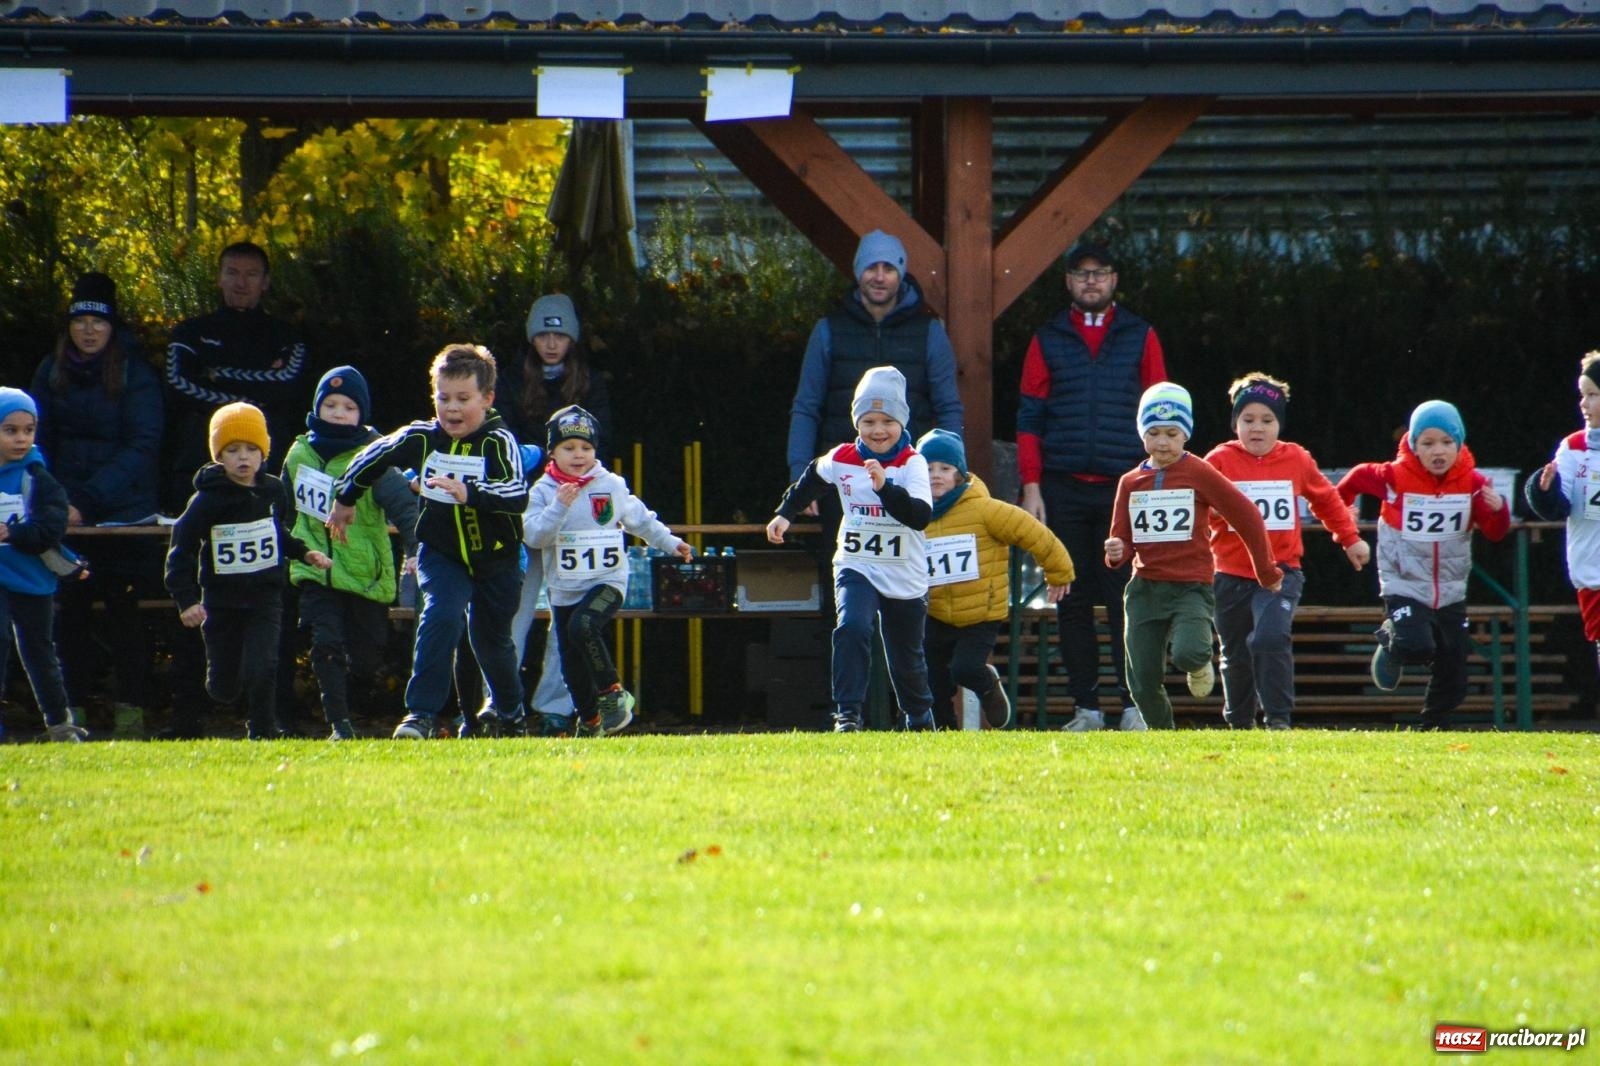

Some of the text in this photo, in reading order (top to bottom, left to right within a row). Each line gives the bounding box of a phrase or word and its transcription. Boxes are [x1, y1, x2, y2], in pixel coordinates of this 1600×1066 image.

[296, 483, 327, 515] 412
[1254, 498, 1290, 520] 06
[1134, 508, 1190, 533] 432
[1406, 511, 1463, 533] 521
[217, 536, 275, 565] 555
[843, 531, 902, 557] 541
[560, 546, 620, 571] 515
